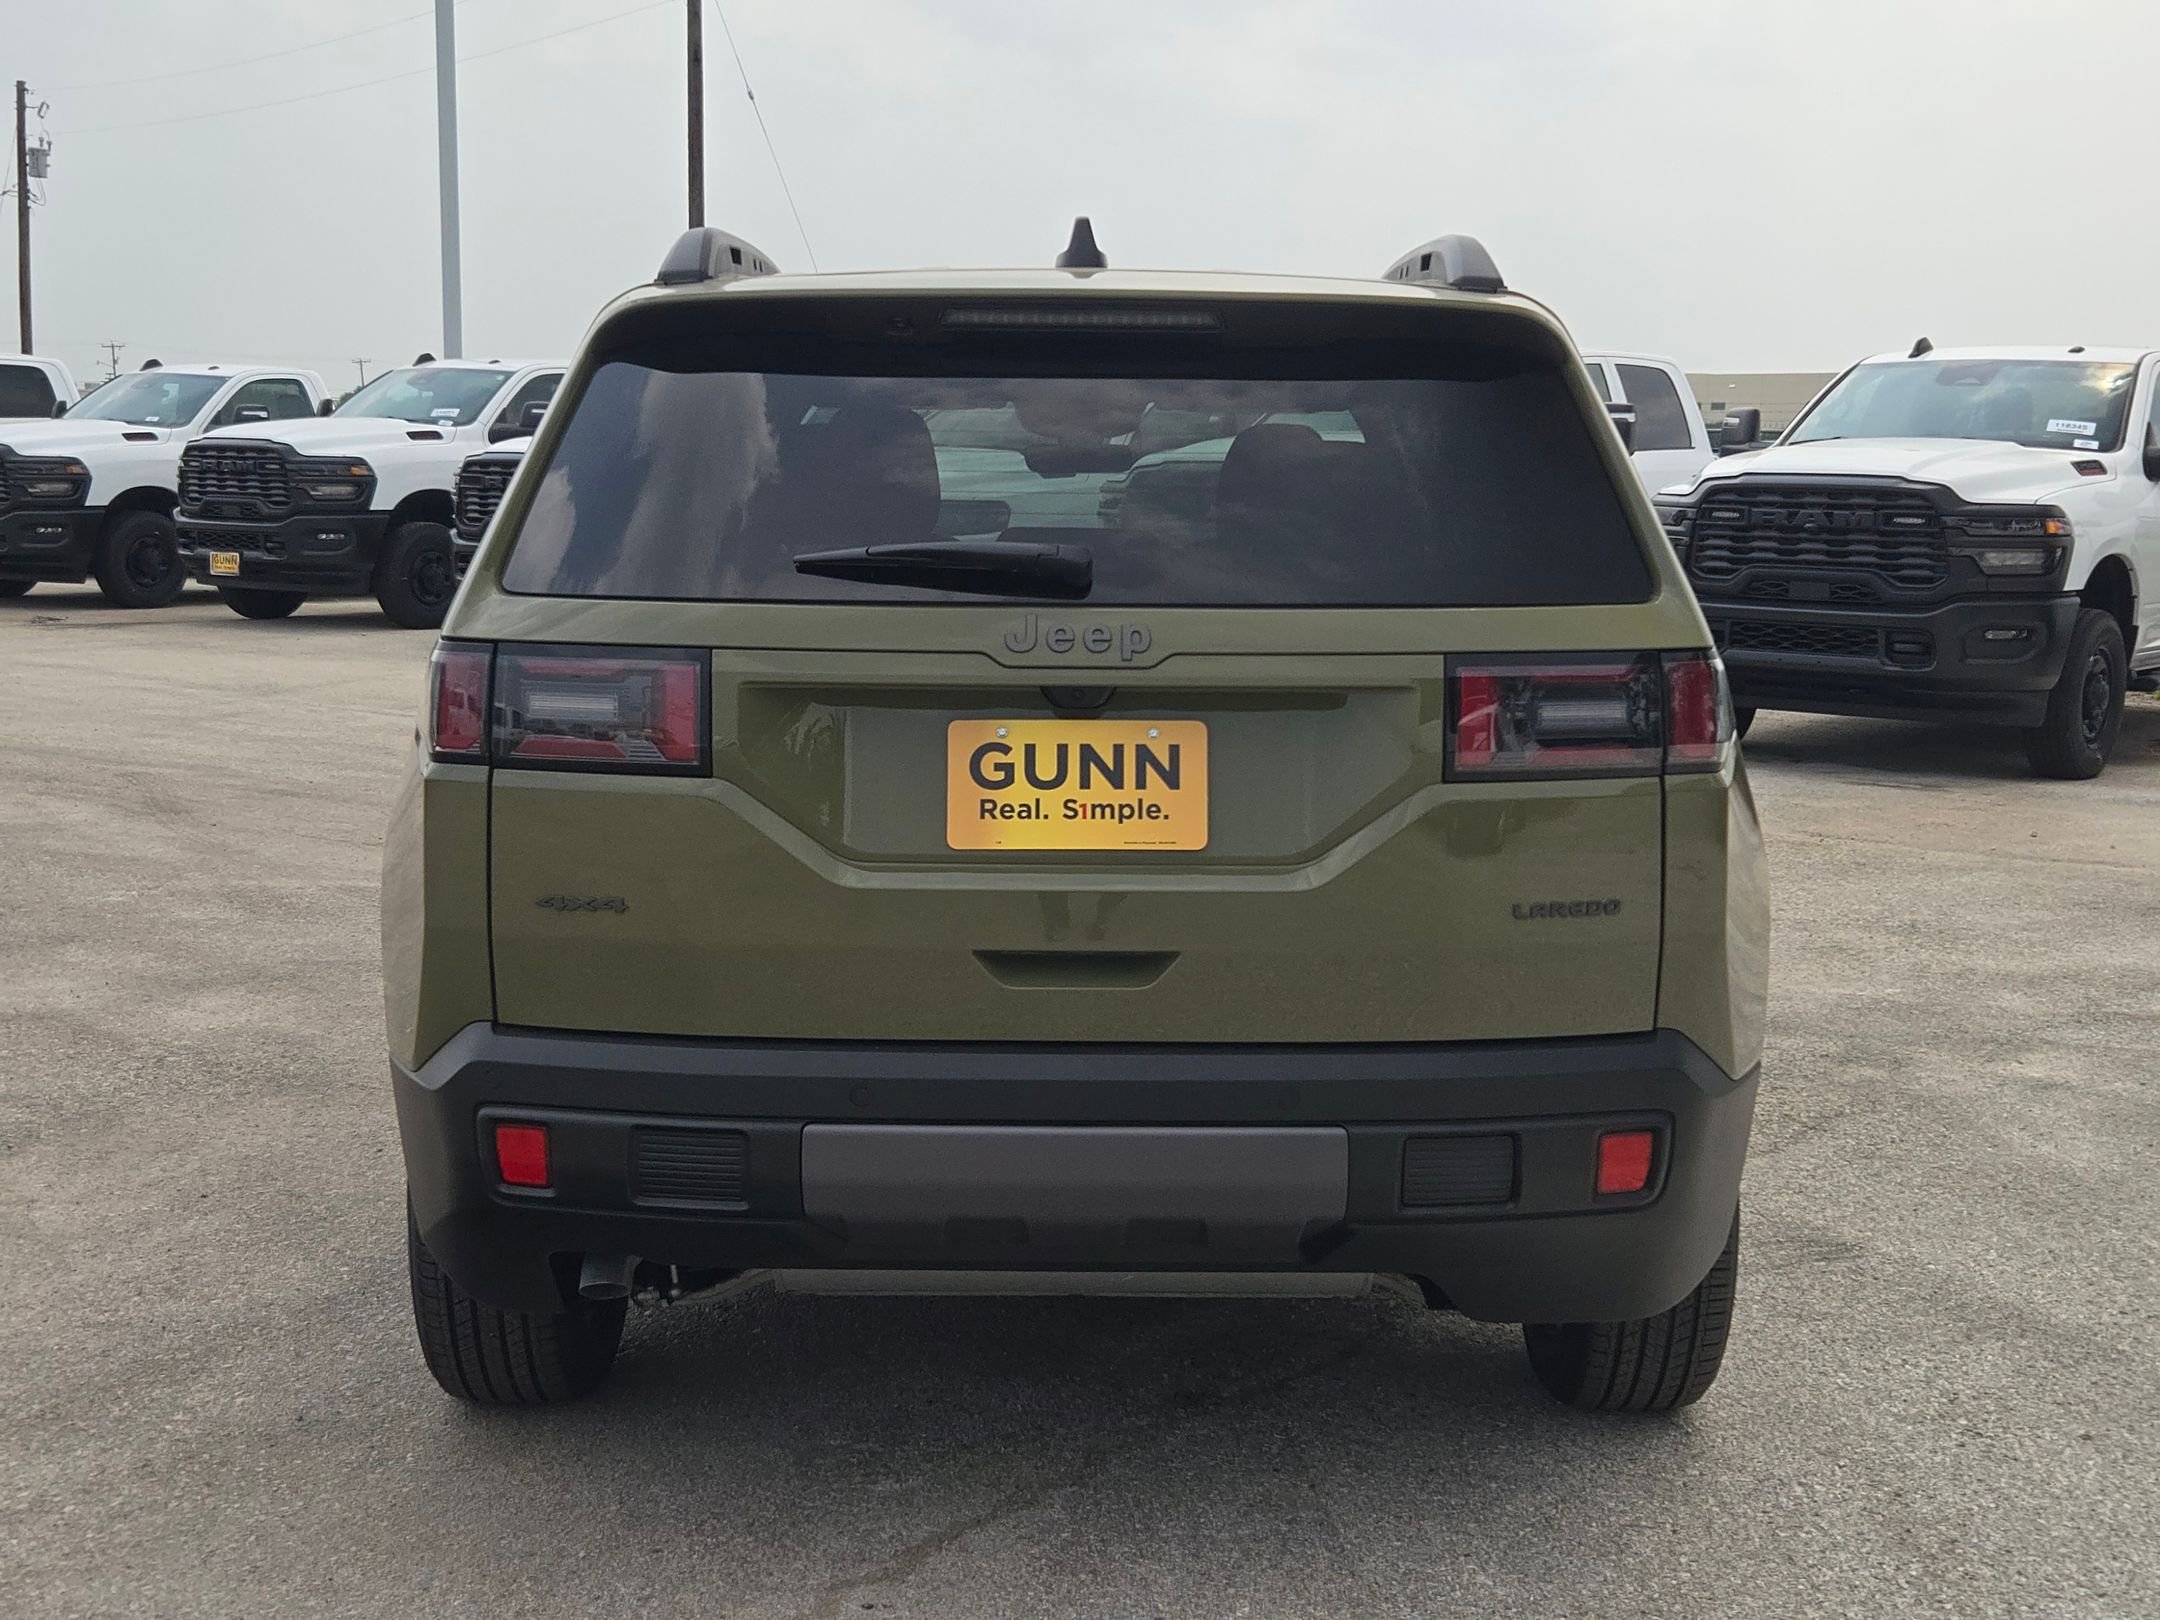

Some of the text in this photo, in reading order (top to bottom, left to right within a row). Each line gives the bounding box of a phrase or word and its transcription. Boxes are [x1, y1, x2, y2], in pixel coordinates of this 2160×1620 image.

[1750, 508, 1875, 532] RAM
[213, 555, 237, 565] GUNN
[1004, 613, 1152, 662] Jeep
[969, 742, 1181, 790] GUNN
[979, 798, 1049, 820] Real.
[1511, 898, 1621, 919] LAREDO
